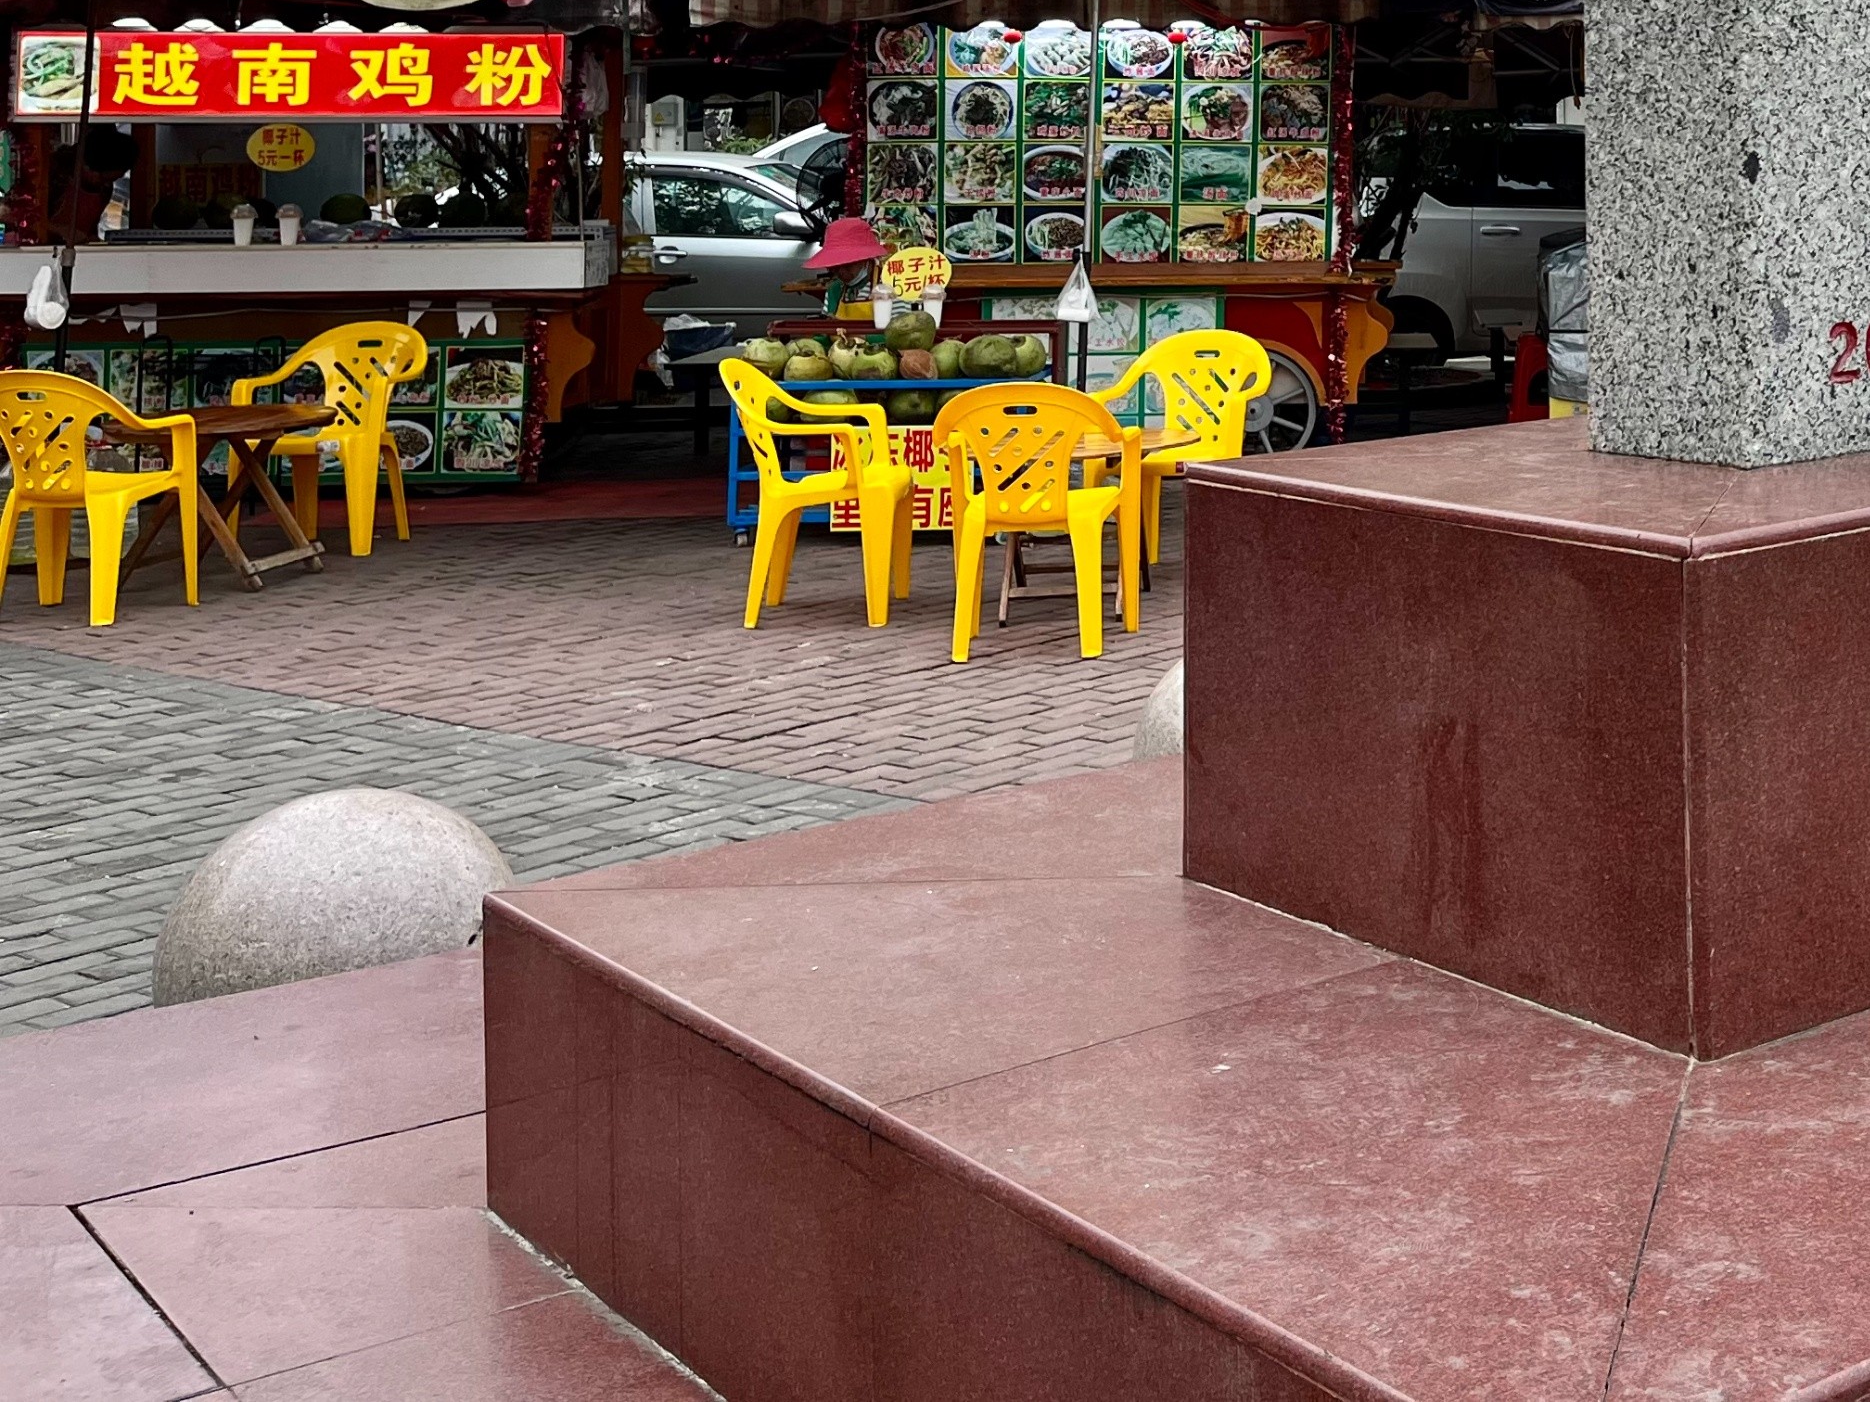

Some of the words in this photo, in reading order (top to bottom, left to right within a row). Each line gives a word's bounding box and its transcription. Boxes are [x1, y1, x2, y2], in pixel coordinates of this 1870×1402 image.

[112, 42, 552, 106] 越南鸡粉
[262, 128, 301, 146] 椰子汁
[257, 150, 305, 167] 5元一杯
[887, 254, 946, 276] 椰子汁
